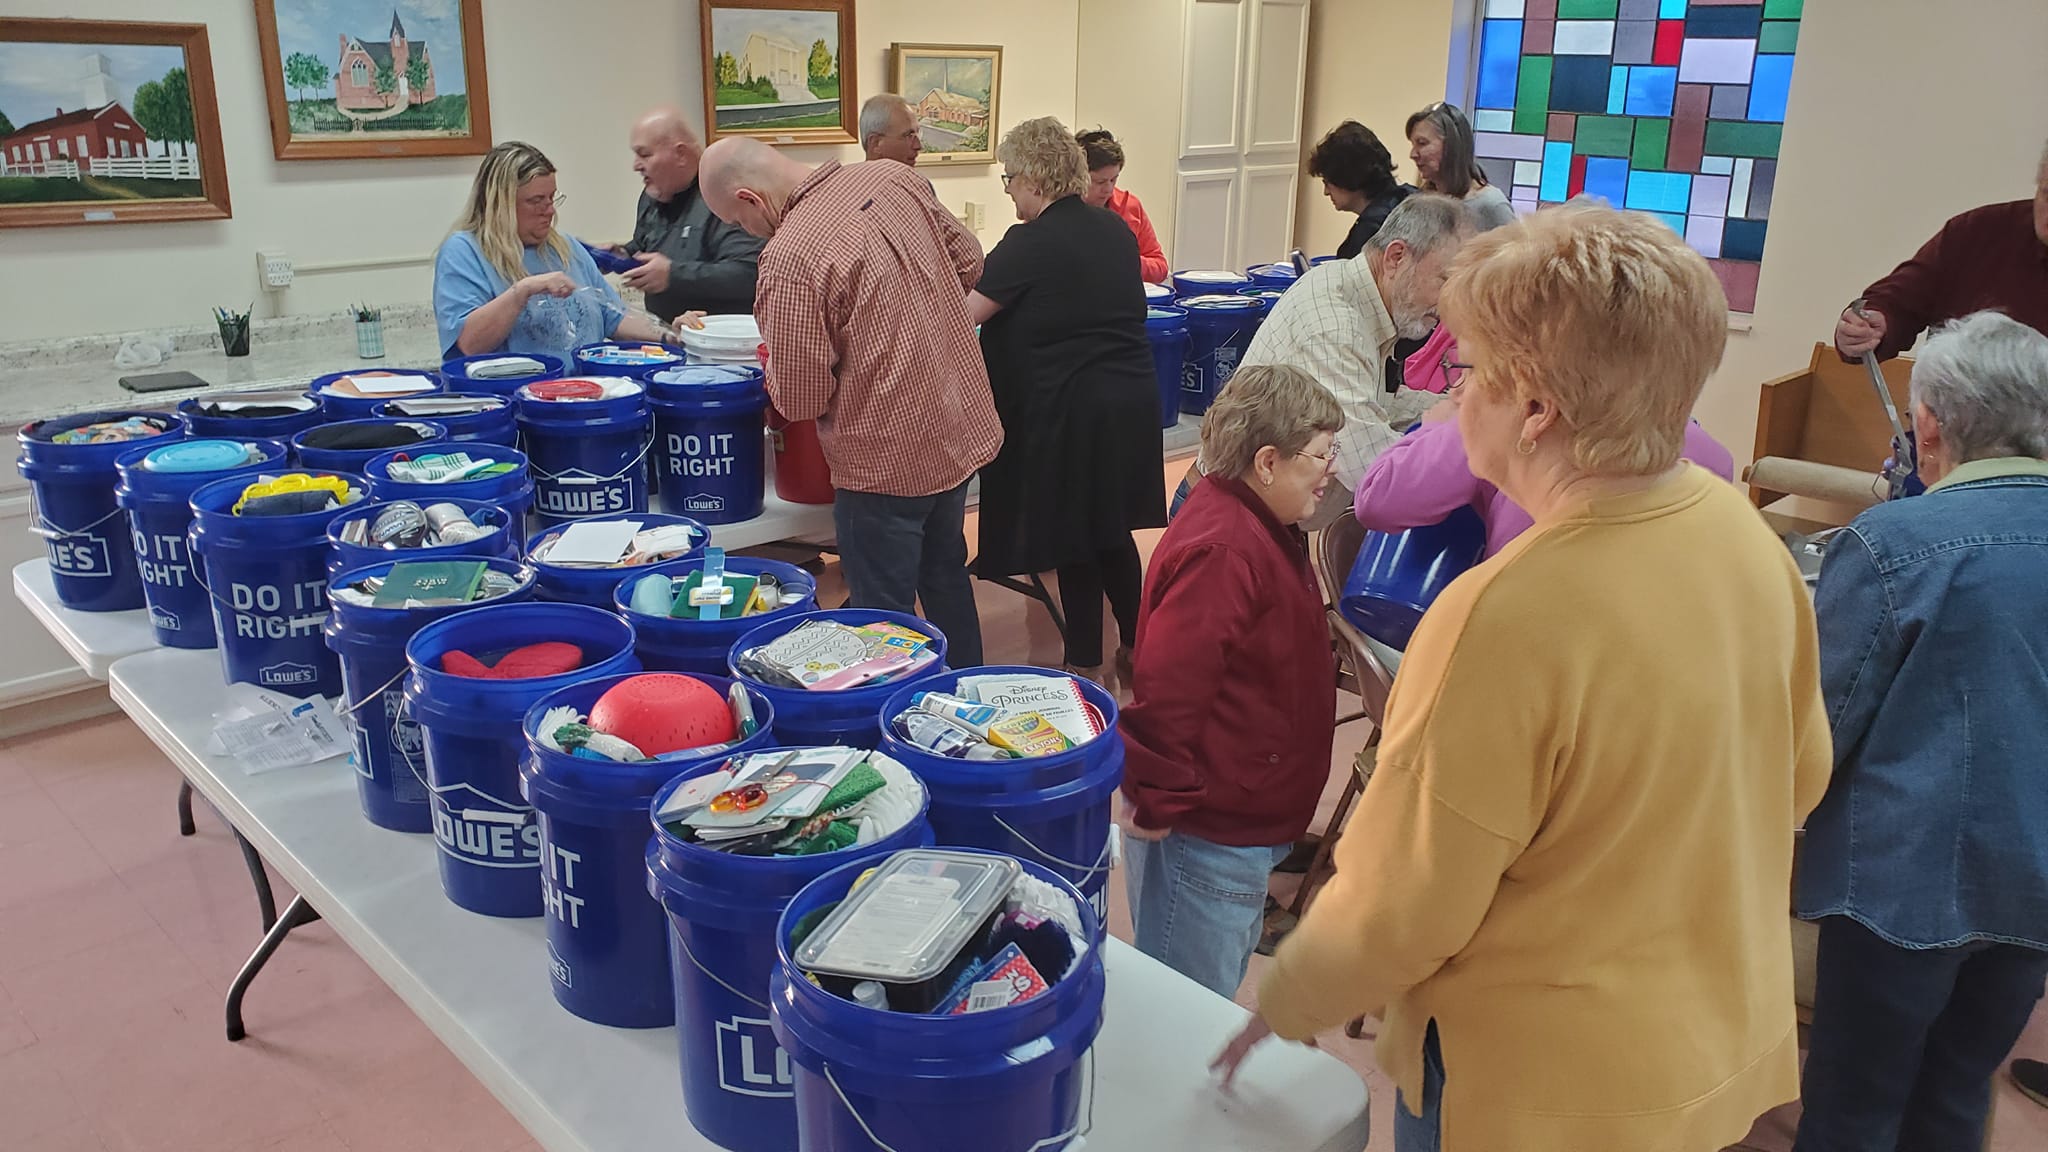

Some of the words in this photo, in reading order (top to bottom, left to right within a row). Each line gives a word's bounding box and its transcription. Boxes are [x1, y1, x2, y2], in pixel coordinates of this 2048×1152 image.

[668, 434, 700, 456] DO
[709, 433, 733, 455] IT
[669, 457, 735, 476] RIGHT
[537, 484, 624, 512] LOWE'S
[688, 499, 720, 509] LOWE'S
[154, 534, 182, 561] IT
[231, 582, 281, 612] DO
[293, 579, 327, 610] IT
[235, 610, 330, 639] RIGHT
[265, 669, 312, 682] LOWE'S
[548, 842, 582, 890] IT
